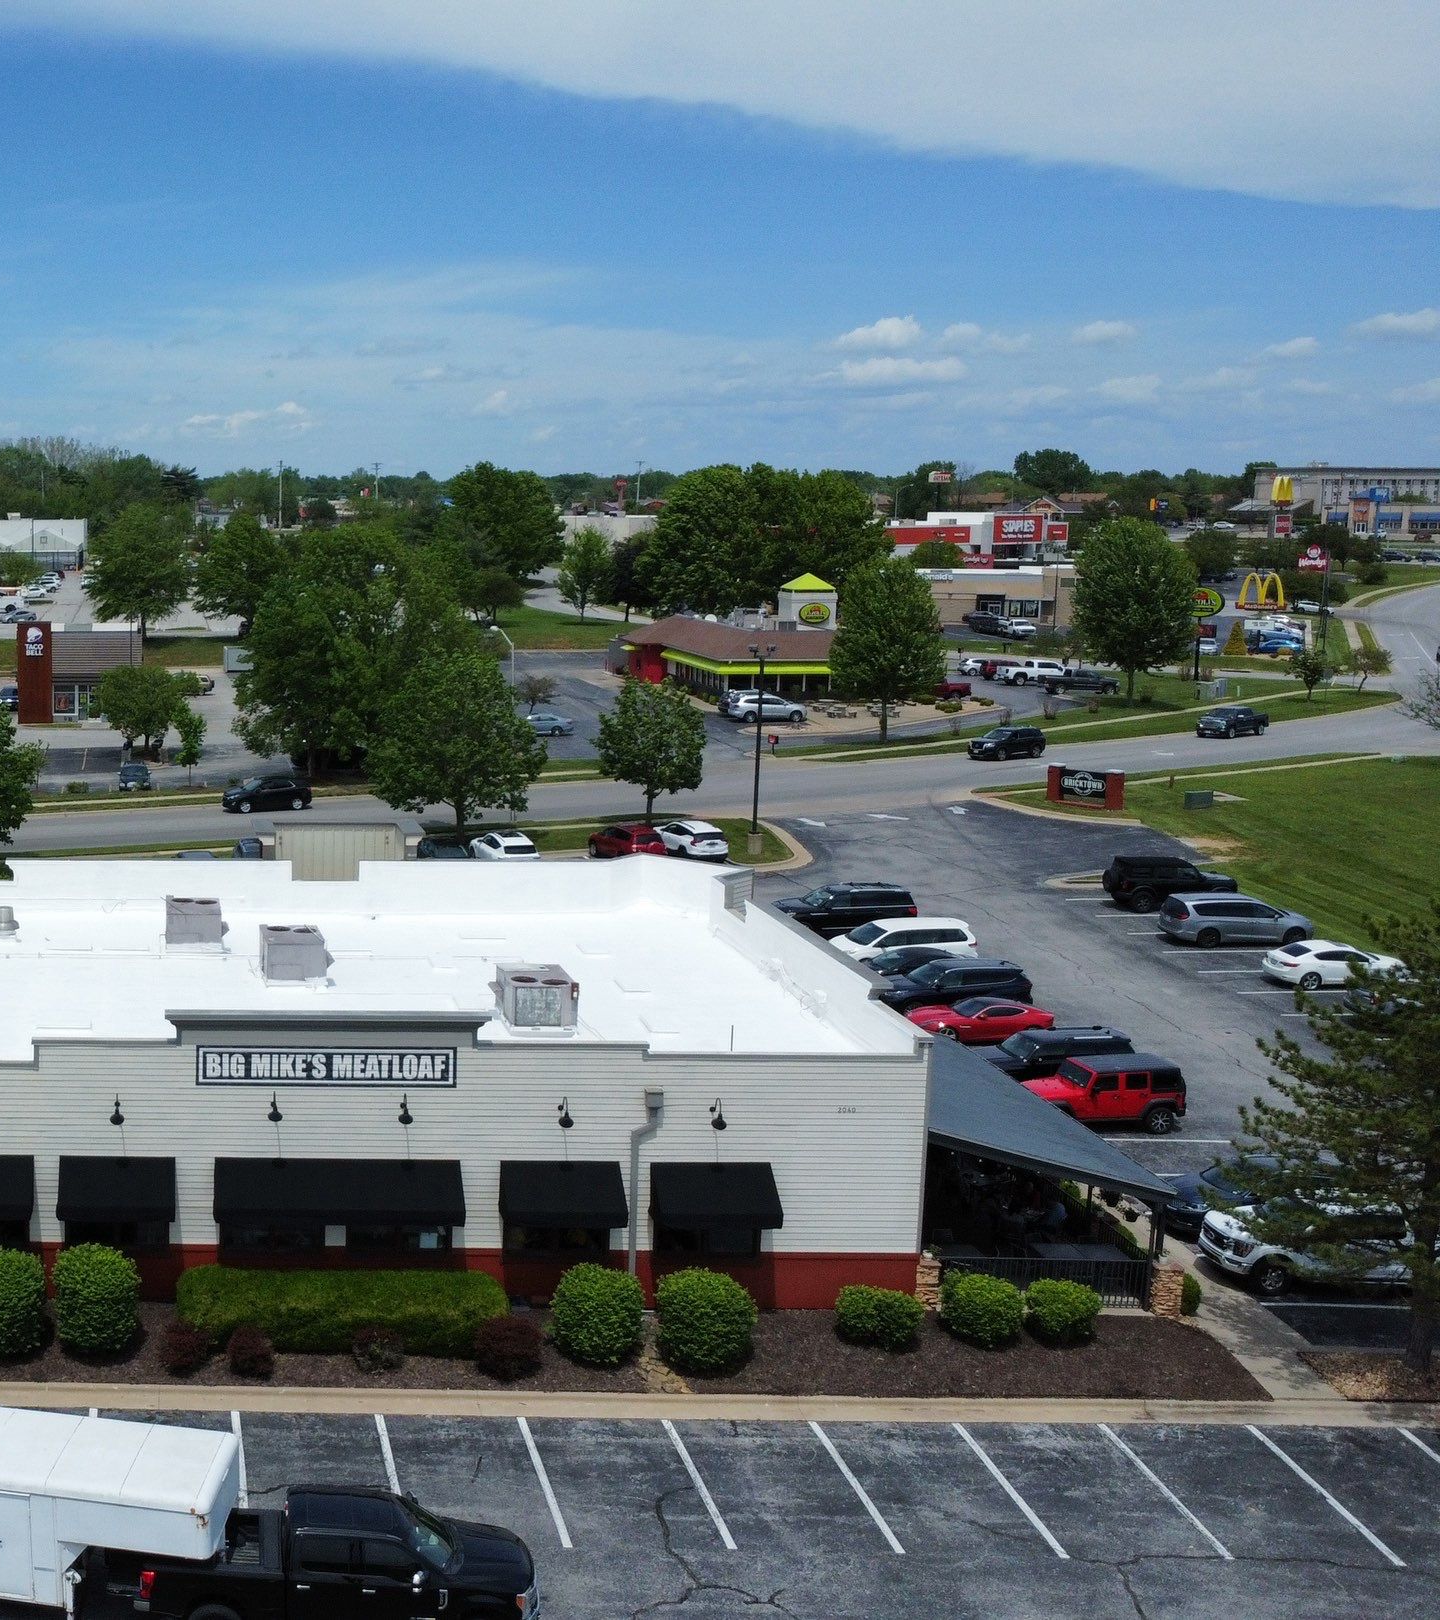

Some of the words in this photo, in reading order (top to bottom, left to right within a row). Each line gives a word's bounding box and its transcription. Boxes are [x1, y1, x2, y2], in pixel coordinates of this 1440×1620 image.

[1002, 520, 1035, 532] STAPLES
[1064, 778, 1102, 789] BRICKTOWN
[205, 1053, 246, 1078] BIG
[250, 1053, 327, 1079] MIKE'S
[332, 1054, 446, 1081] MEATLOAF
